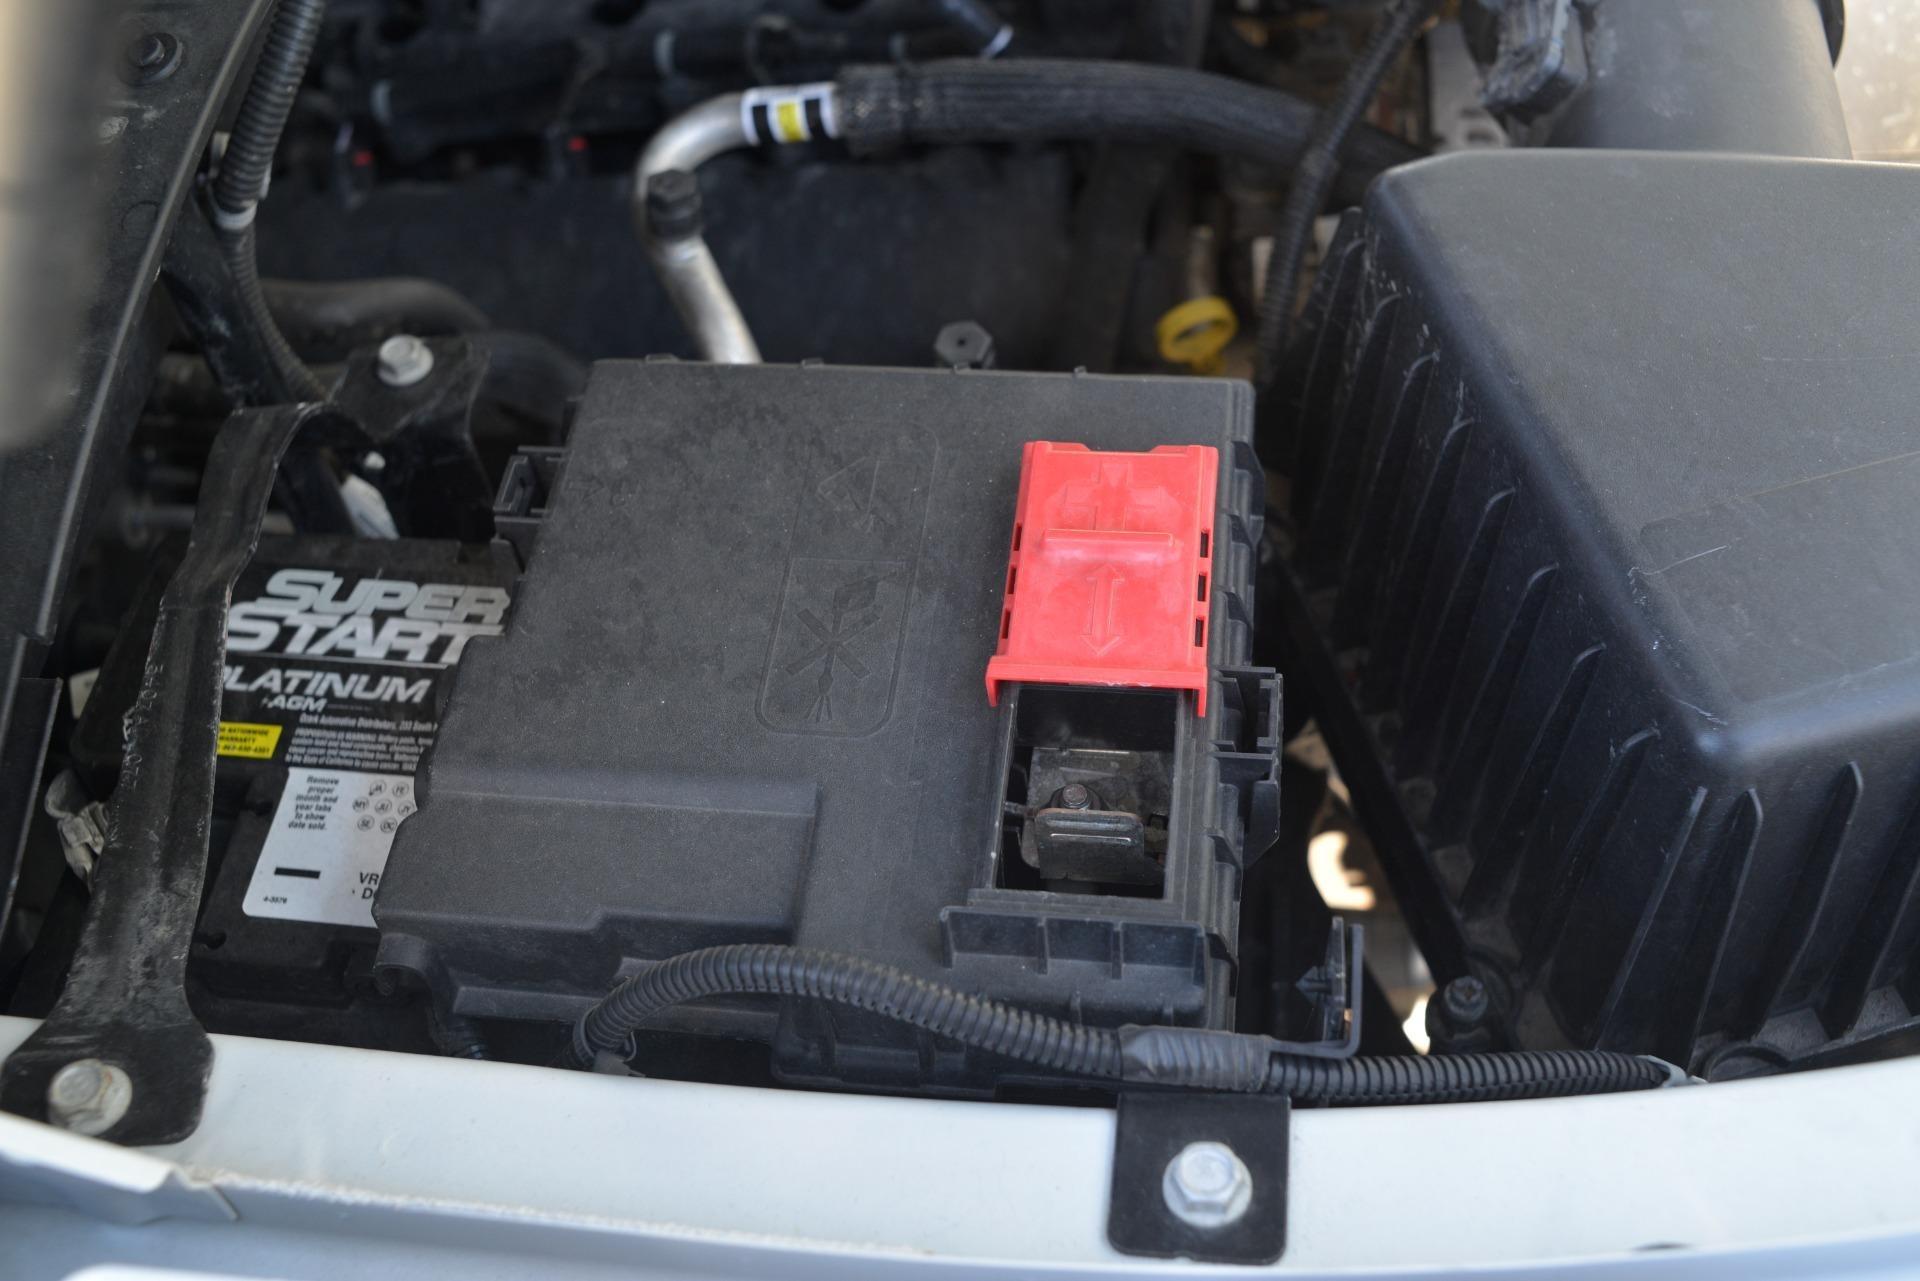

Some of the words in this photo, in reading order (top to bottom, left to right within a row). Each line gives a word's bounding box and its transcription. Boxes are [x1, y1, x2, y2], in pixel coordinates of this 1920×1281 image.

[255, 568, 511, 624] SUPER
[225, 602, 505, 665] START
[306, 774, 340, 785] Remove
[306, 786, 335, 795] proper
[295, 793, 321, 802] month
[323, 794, 339, 804] and
[294, 803, 313, 813] year
[304, 812, 326, 821] show
[287, 820, 306, 829] date
[361, 887, 375, 900] D
